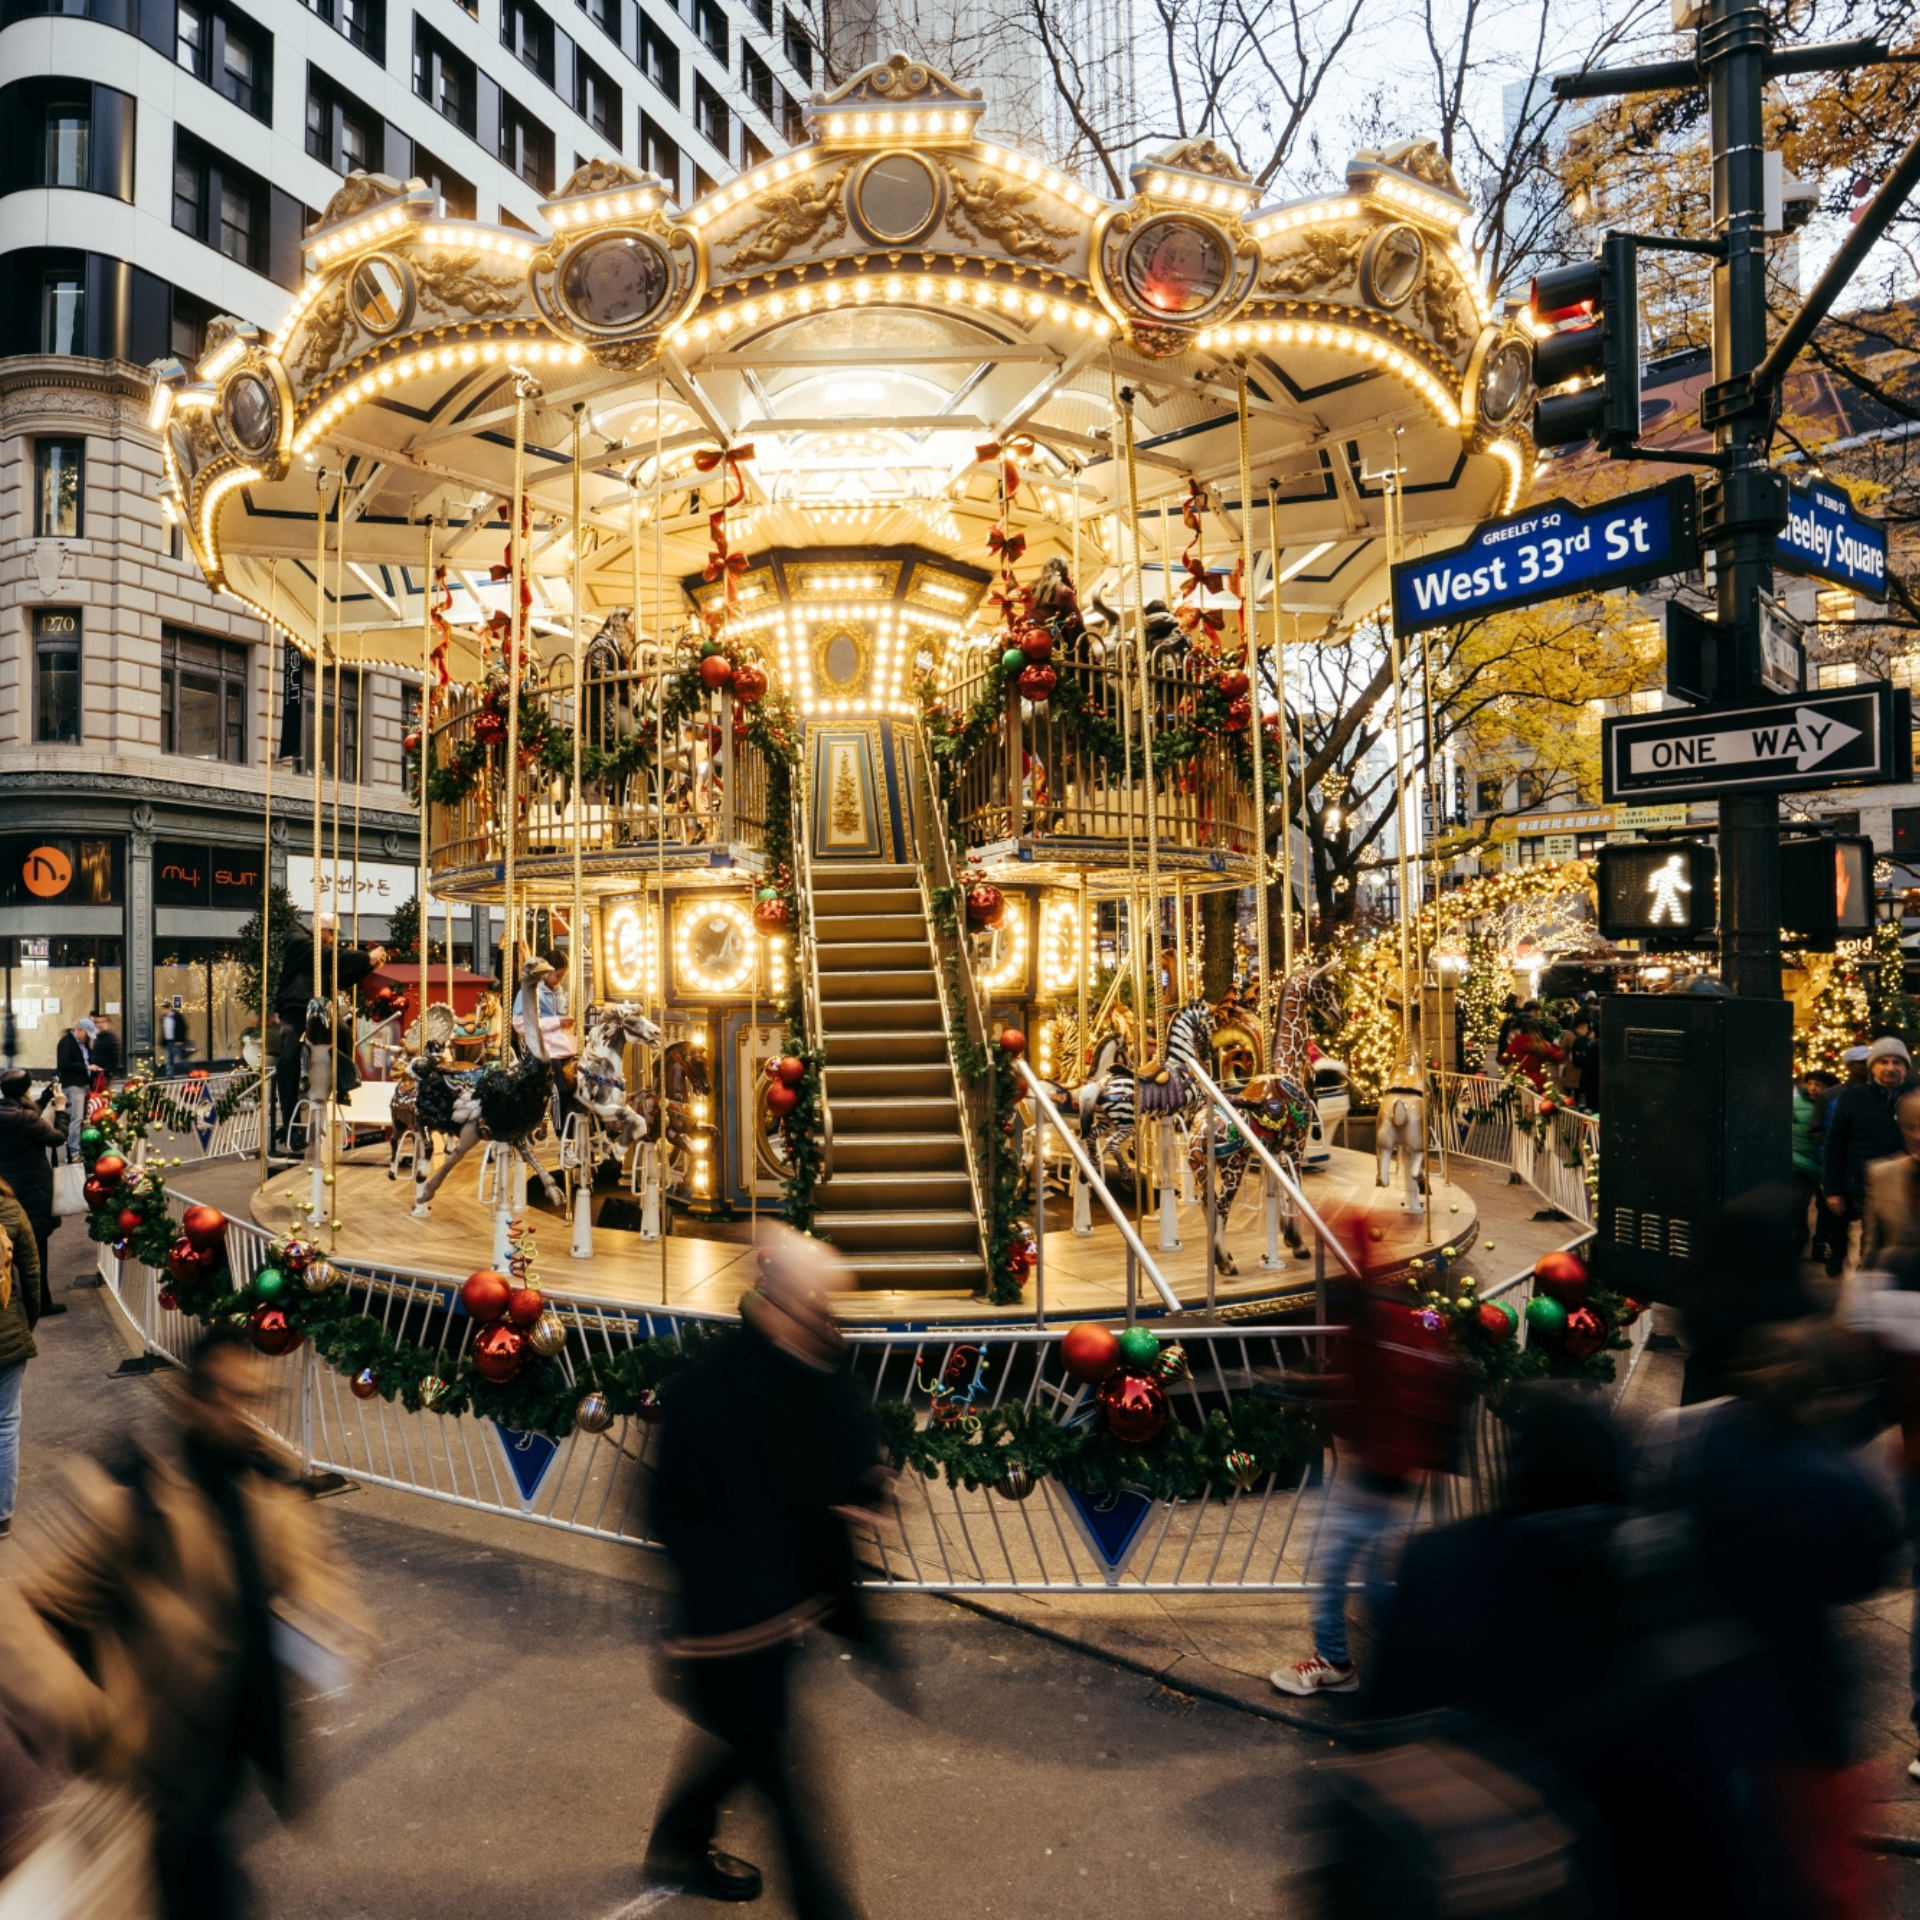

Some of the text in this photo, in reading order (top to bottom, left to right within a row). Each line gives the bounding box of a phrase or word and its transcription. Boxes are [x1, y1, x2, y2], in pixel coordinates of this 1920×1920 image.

[1816, 492, 1846, 515] W 33RD ST
[1482, 513, 1561, 546] GREELEY SQ
[1413, 516, 1651, 611] West 33rd St
[1836, 523, 1884, 579] Square
[42, 615, 75, 632] 1270
[1651, 722, 1832, 768] ONE WAY
